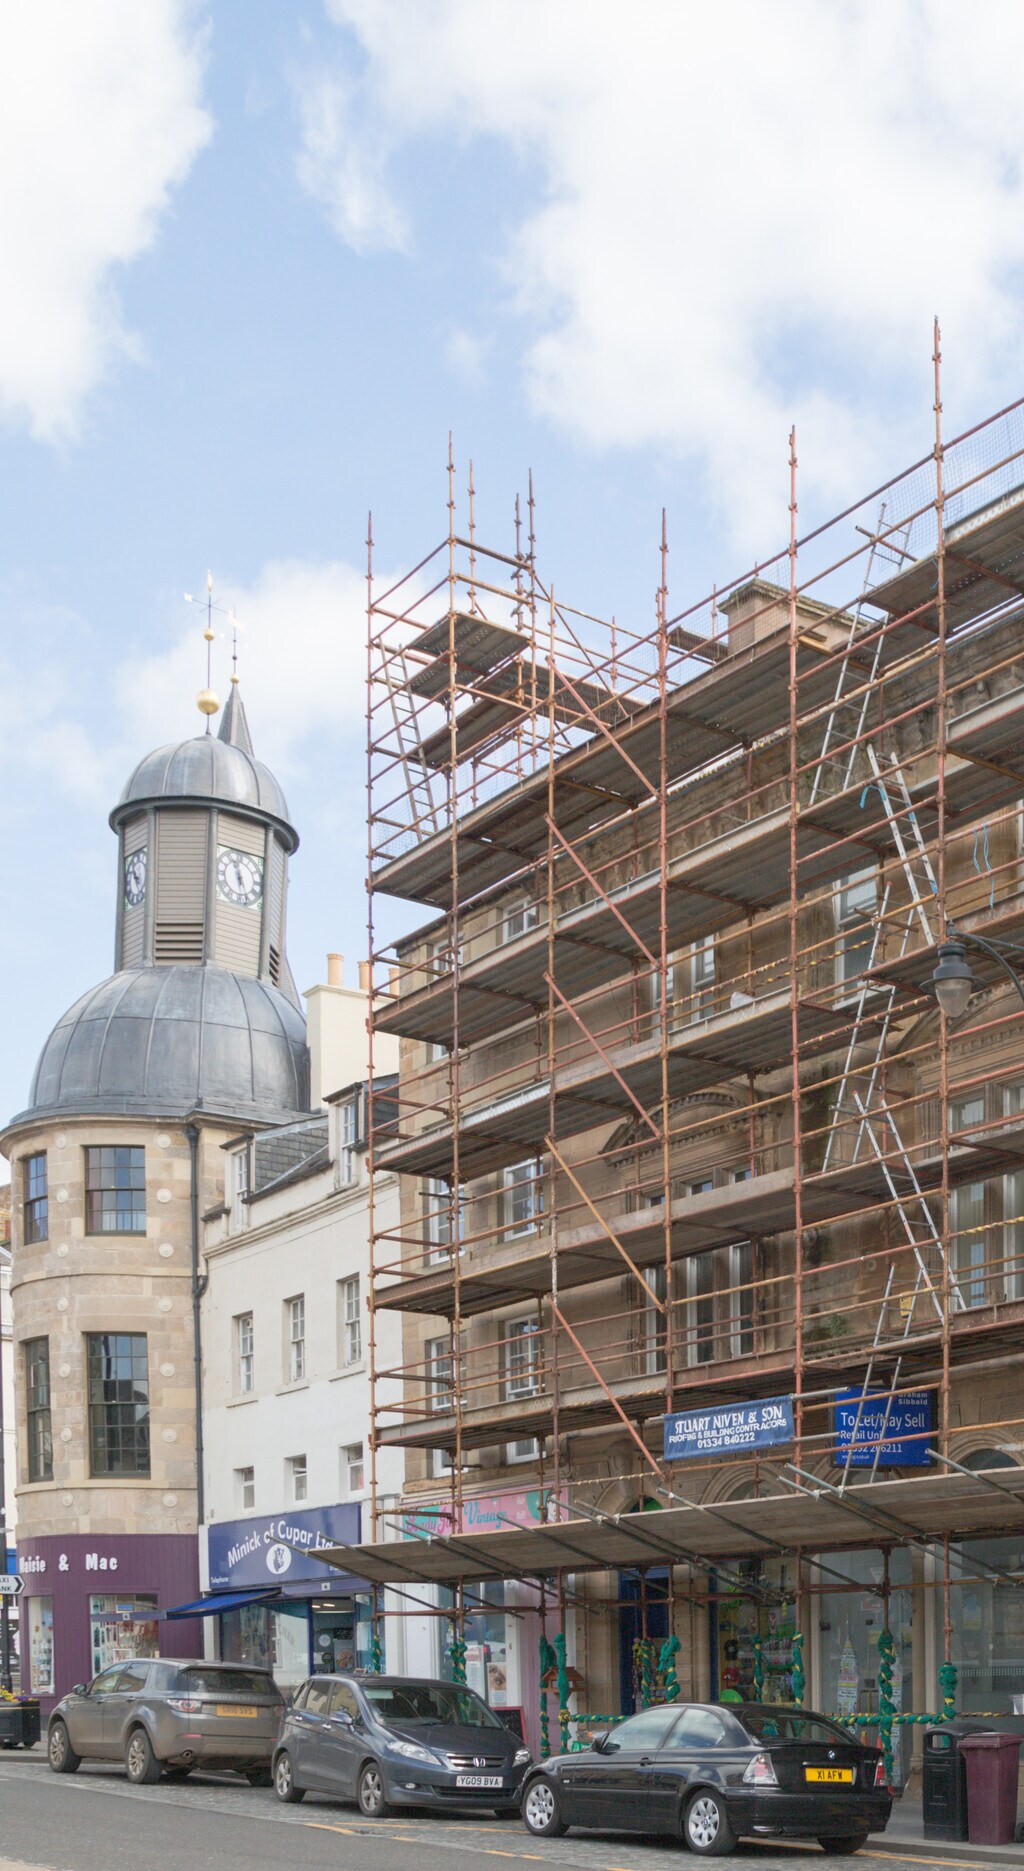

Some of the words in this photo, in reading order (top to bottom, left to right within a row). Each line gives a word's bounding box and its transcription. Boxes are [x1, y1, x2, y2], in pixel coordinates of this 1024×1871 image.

[674, 1416, 711, 1434] STUART
[713, 1411, 744, 1429] NIVEN
[748, 1411, 757, 1423] &
[761, 1405, 783, 1422] SON
[840, 1412, 855, 1427] To
[904, 1412, 925, 1428] Sell
[697, 1431, 703, 1439] &
[697, 1436, 723, 1449] 01334
[724, 1432, 755, 1446] 840222
[840, 1430, 865, 1440] Reail
[867, 1430, 886, 1440] Uni
[227, 1530, 261, 1568] Minick
[263, 1522, 275, 1544] of
[277, 1520, 313, 1545] Cupar
[58, 1553, 69, 1571] &
[85, 1552, 118, 1571] Mac
[460, 1776, 482, 1786] YG09
[483, 1777, 499, 1786] BVA
[827, 1770, 843, 1780] AFW
